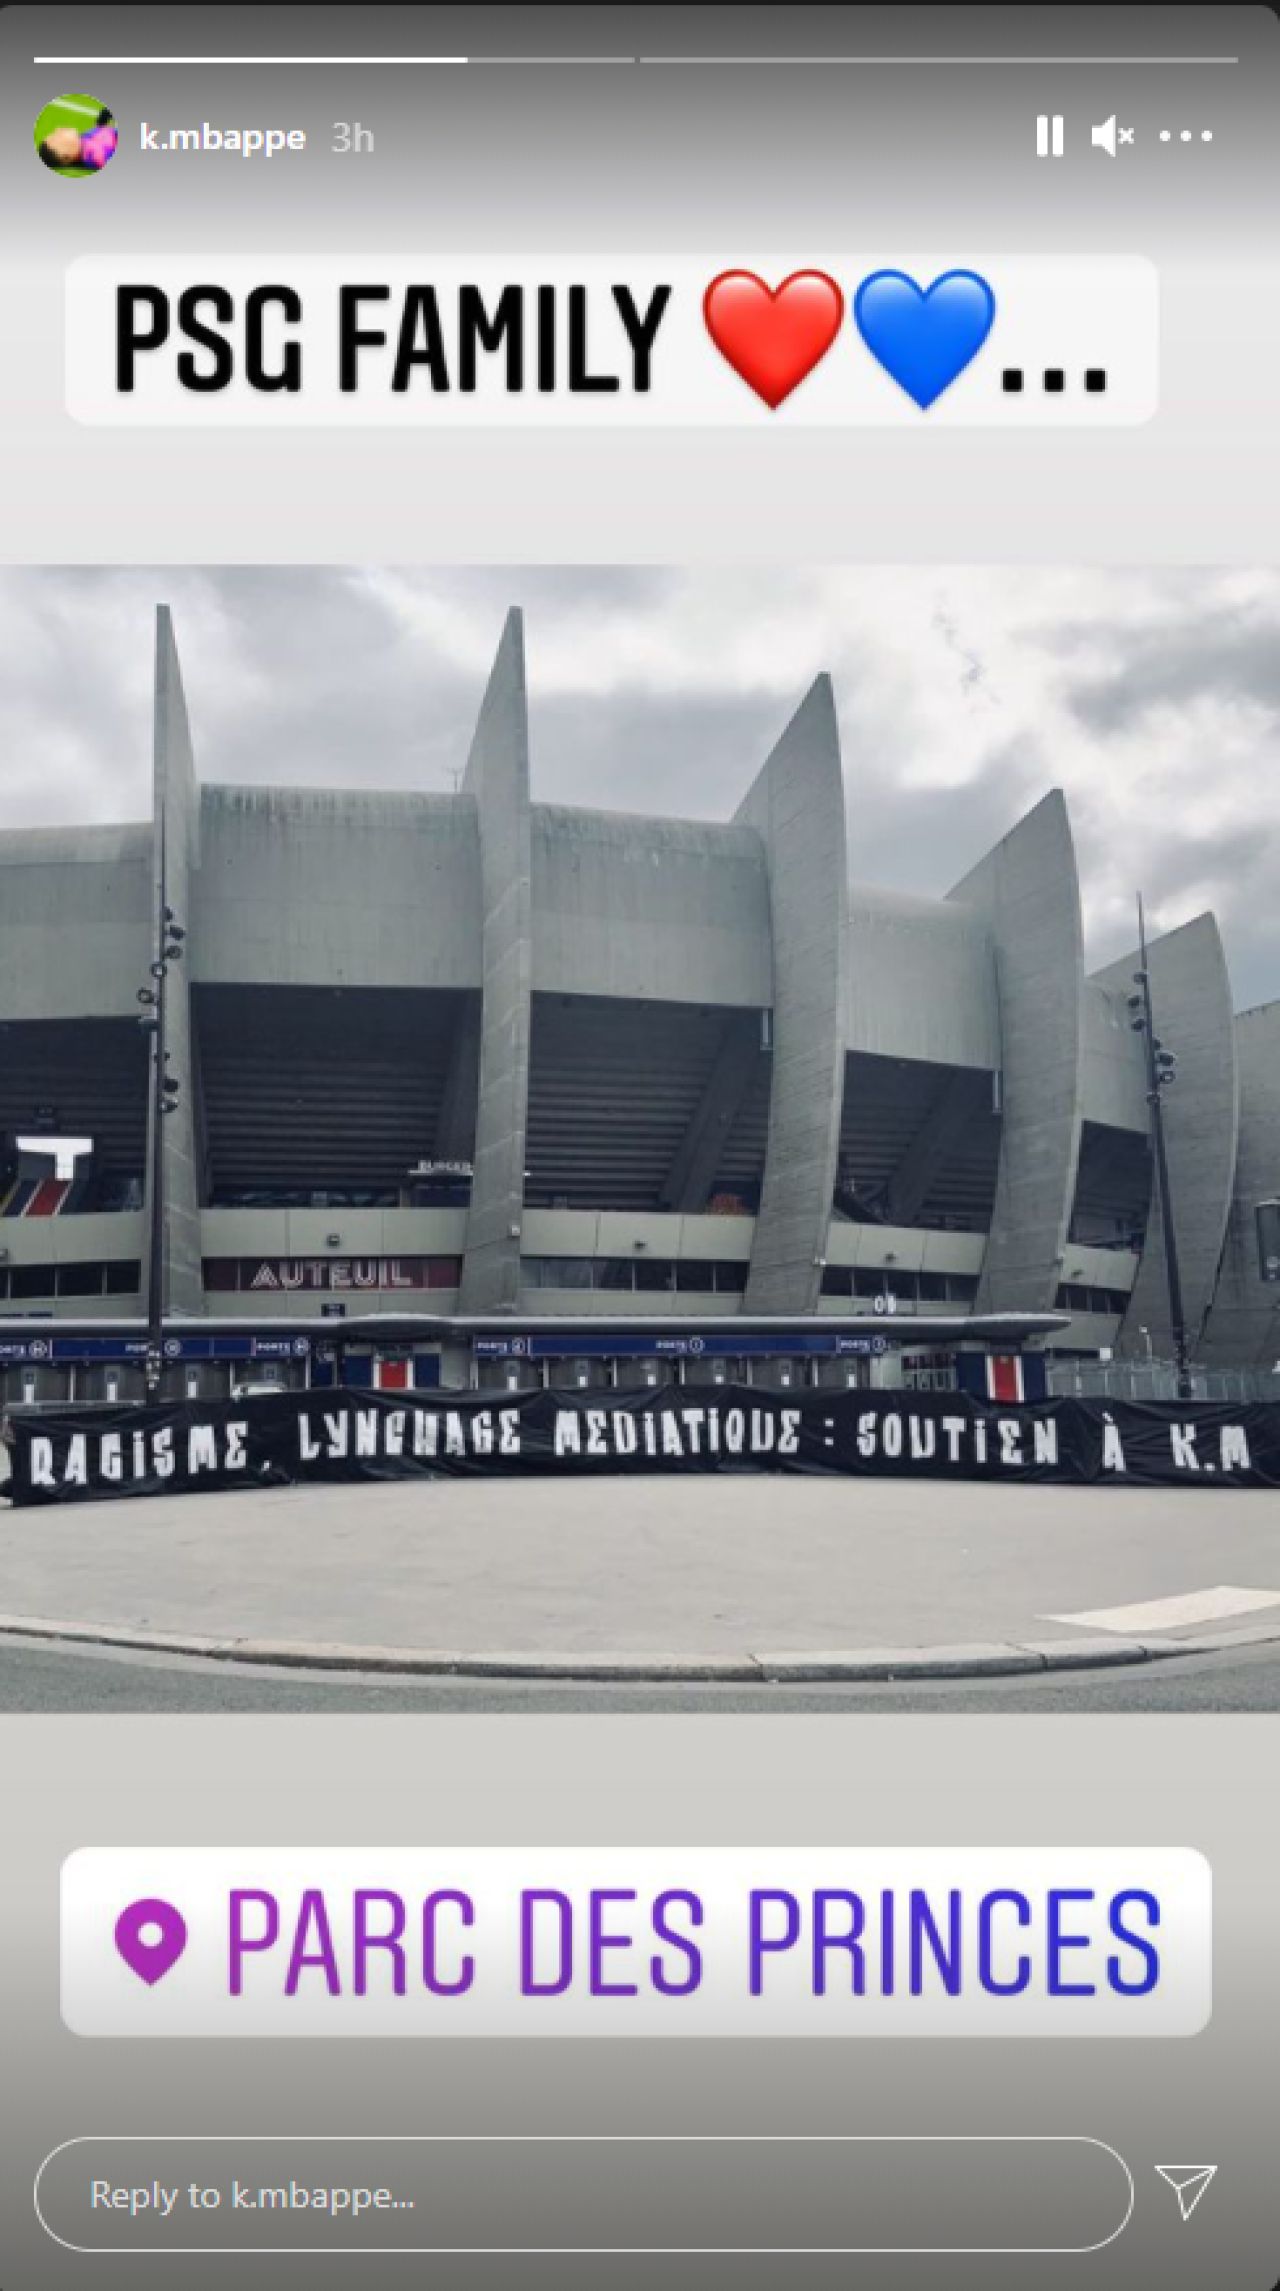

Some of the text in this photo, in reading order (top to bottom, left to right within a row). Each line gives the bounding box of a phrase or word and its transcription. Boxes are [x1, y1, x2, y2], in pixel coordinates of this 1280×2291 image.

[250, 1260, 412, 1288] AUTEUIL
[554, 1408, 801, 1457] MEDIATIQUE
[857, 1410, 1059, 1465] SOUTIEN
[1169, 1413, 1251, 1471] K.M
